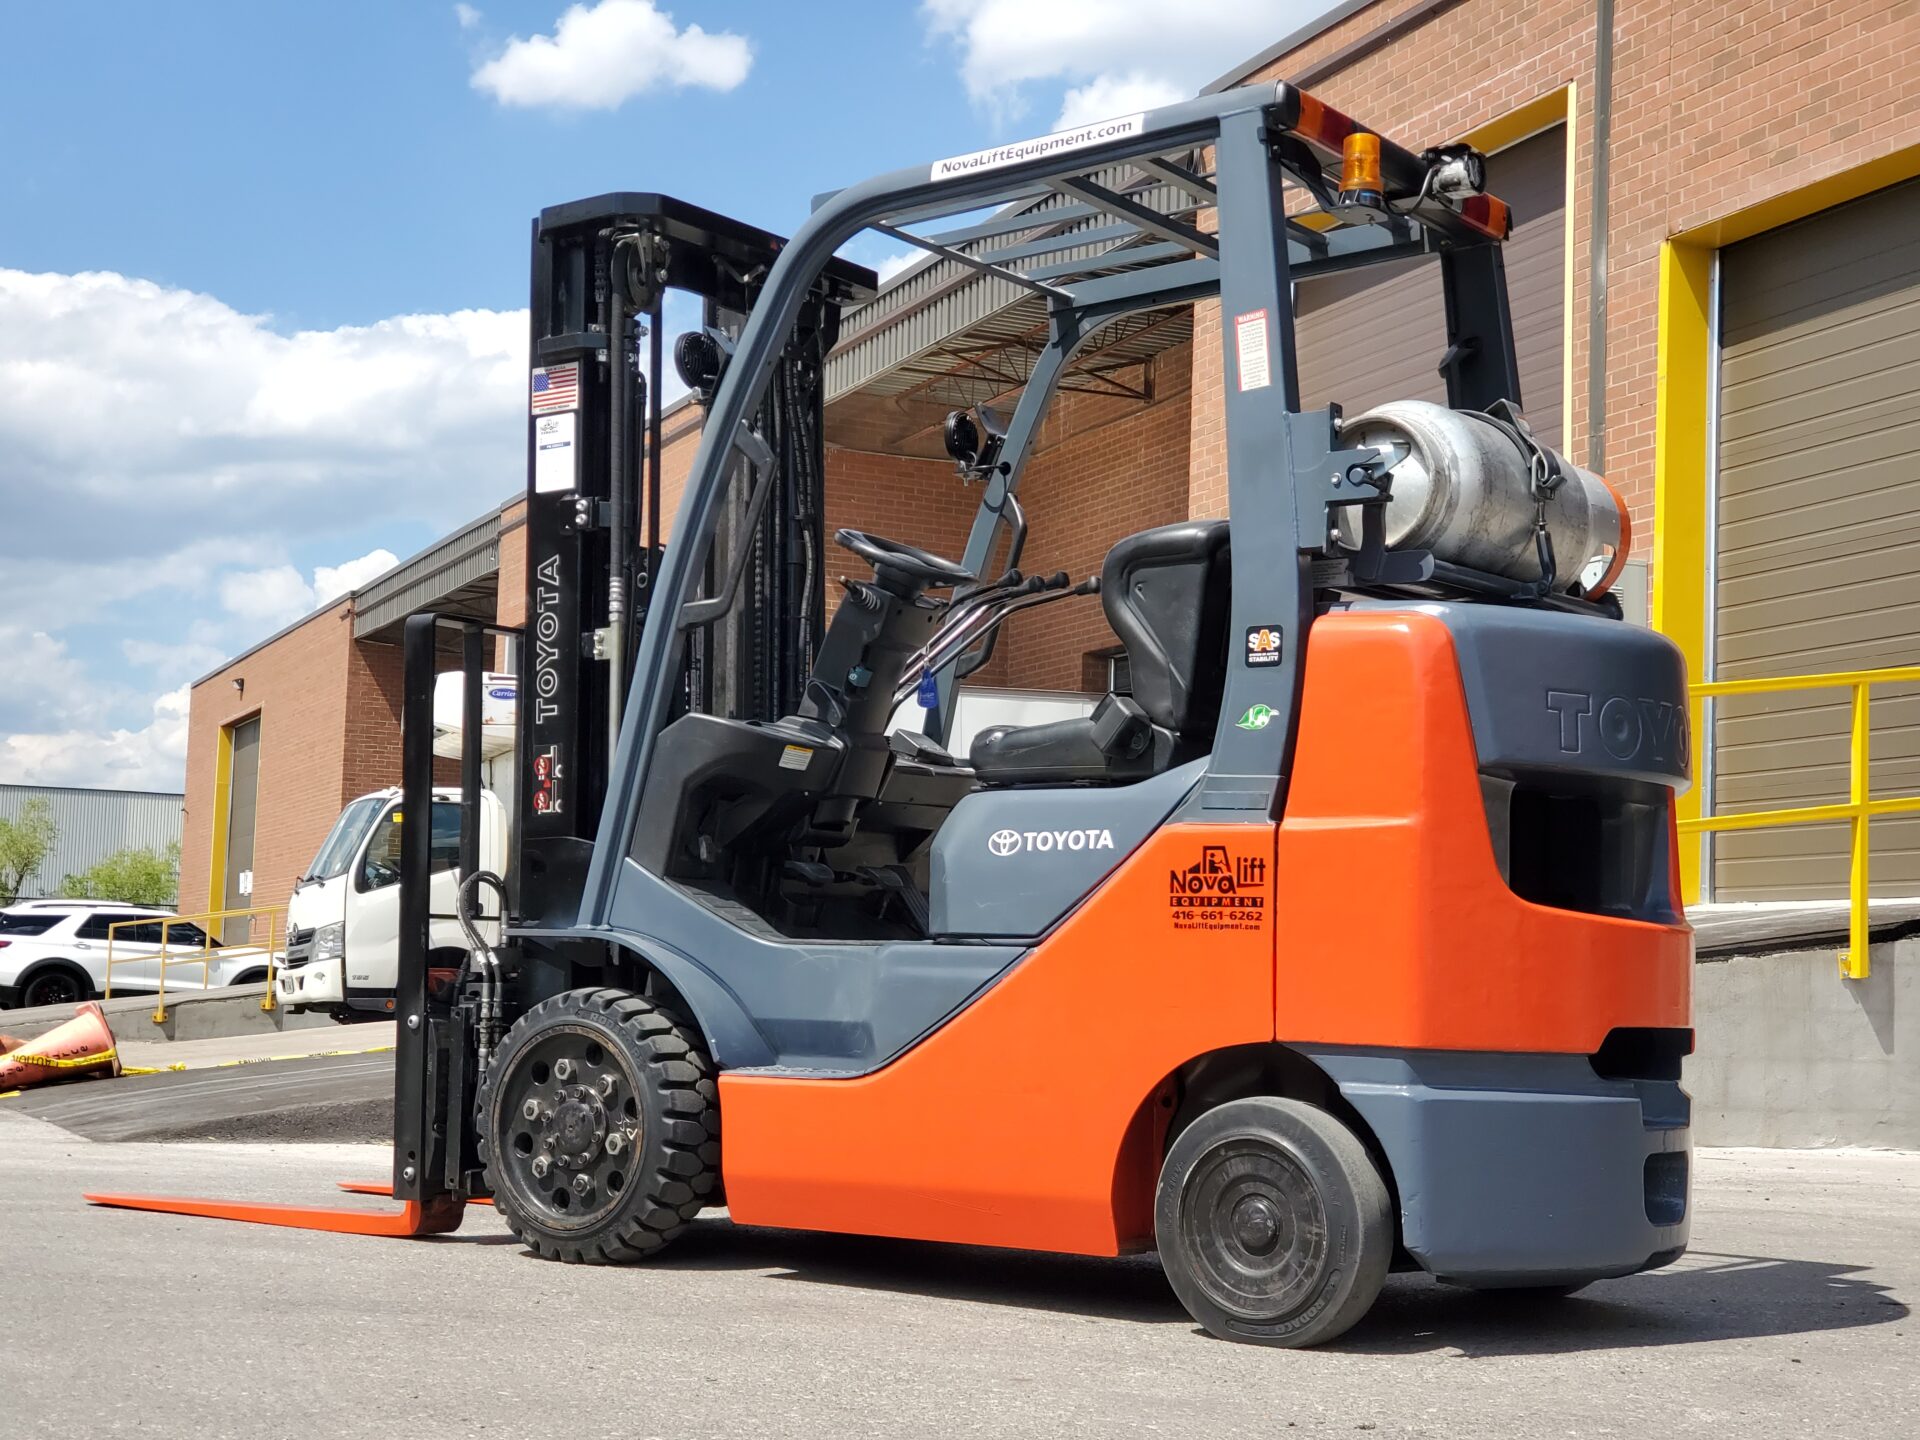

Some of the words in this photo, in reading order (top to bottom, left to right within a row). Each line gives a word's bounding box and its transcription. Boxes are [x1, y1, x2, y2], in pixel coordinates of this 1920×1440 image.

[941, 122, 1132, 173] NovaLiftEquipment.com
[535, 554, 560, 724] TOYOTA
[1248, 629, 1281, 651] SAS
[1023, 829, 1114, 851] TOYOTA
[1172, 897, 1262, 906] EQUIPMENT
[1172, 911, 1263, 921] 416-661-6262
[1173, 922, 1260, 930] NovaLiftEquipment.com
